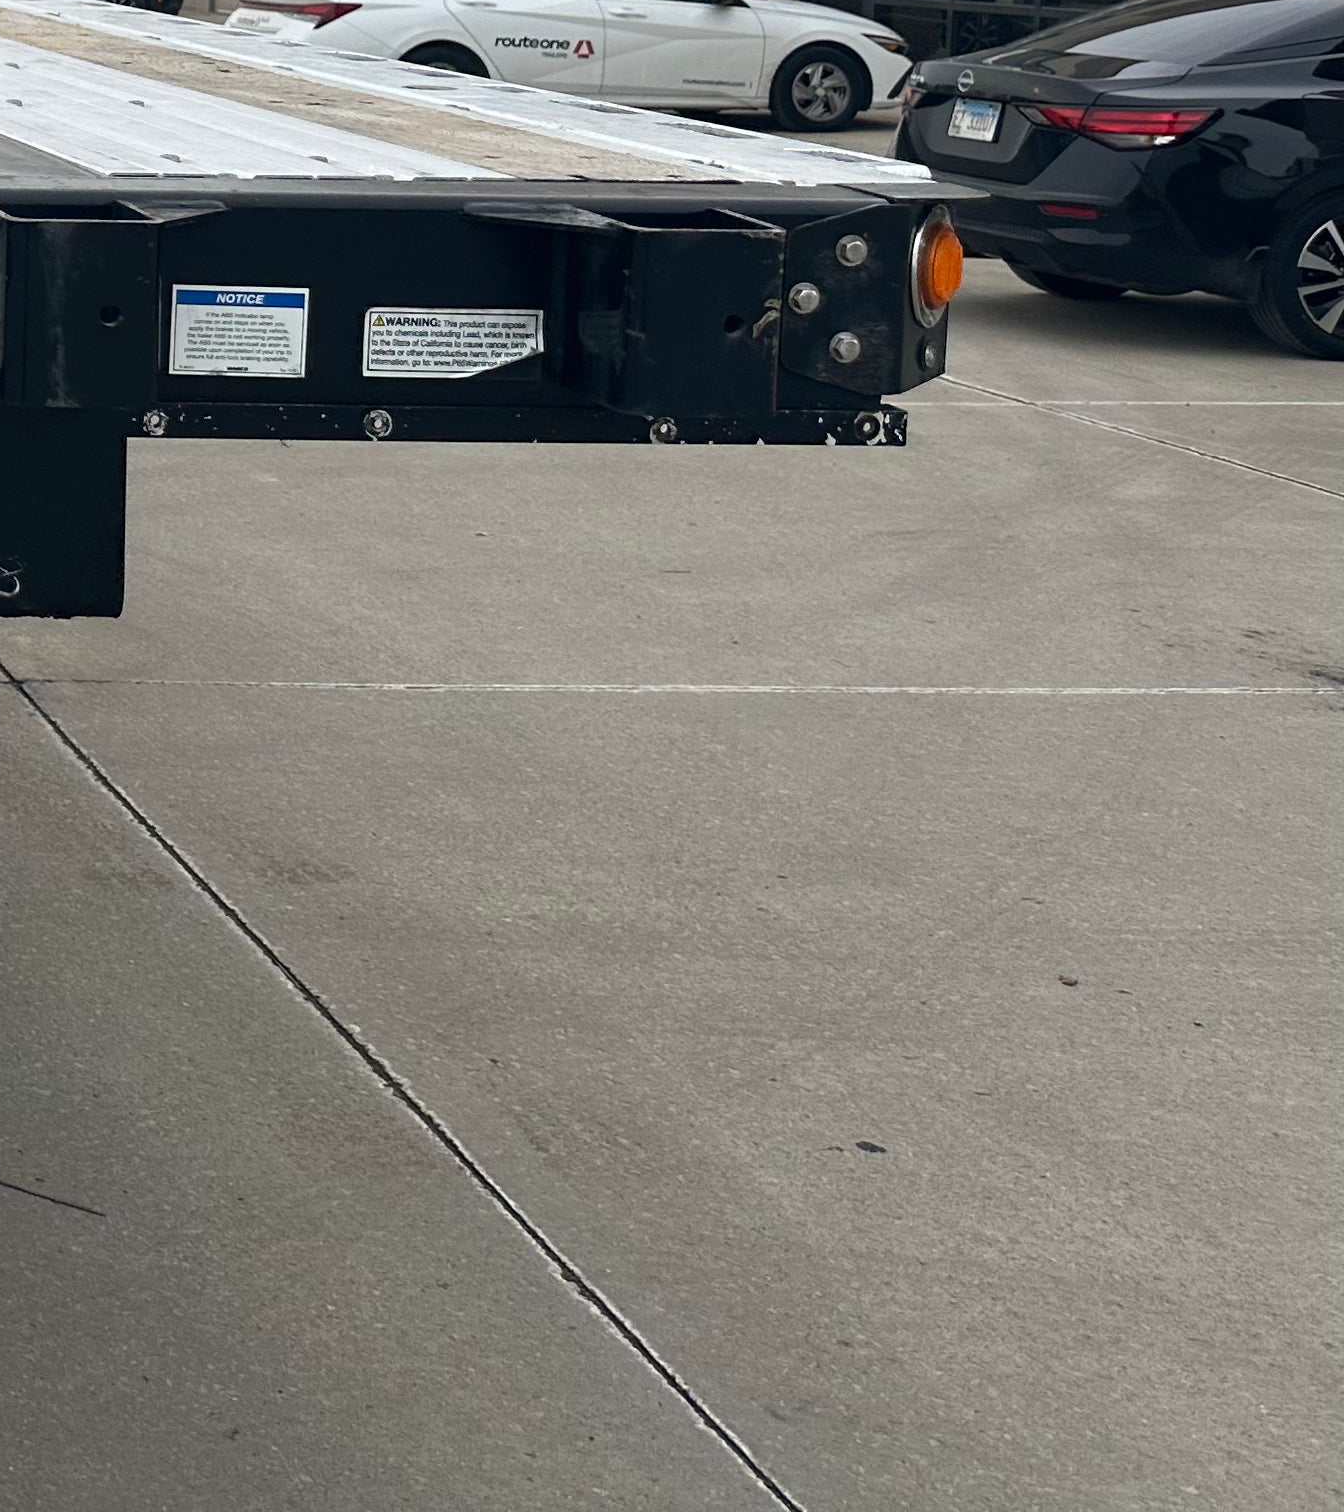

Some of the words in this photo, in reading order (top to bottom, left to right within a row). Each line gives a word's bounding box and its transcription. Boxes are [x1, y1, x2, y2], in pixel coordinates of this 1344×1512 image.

[494, 37, 571, 50] routeone
[215, 292, 265, 304] NOTICE
[384, 316, 441, 327] WARNING:
[442, 319, 458, 328] This
[458, 320, 486, 329] product
[486, 321, 500, 329] can
[500, 322, 527, 330] expose
[371, 329, 384, 338] you
[385, 328, 392, 336] to
[394, 328, 429, 337] chemicals
[429, 329, 461, 339] including
[512, 331, 534, 339] known
[370, 338, 378, 346] to
[379, 338, 391, 346] the
[411, 338, 419, 347] of
[420, 338, 453, 348] California
[453, 339, 461, 348] to
[510, 340, 527, 349] birth
[370, 347, 396, 356] defects
[405, 348, 424, 357] other
[425, 349, 468, 358] reproductive
[490, 349, 503, 358] For
[503, 350, 524, 359] more
